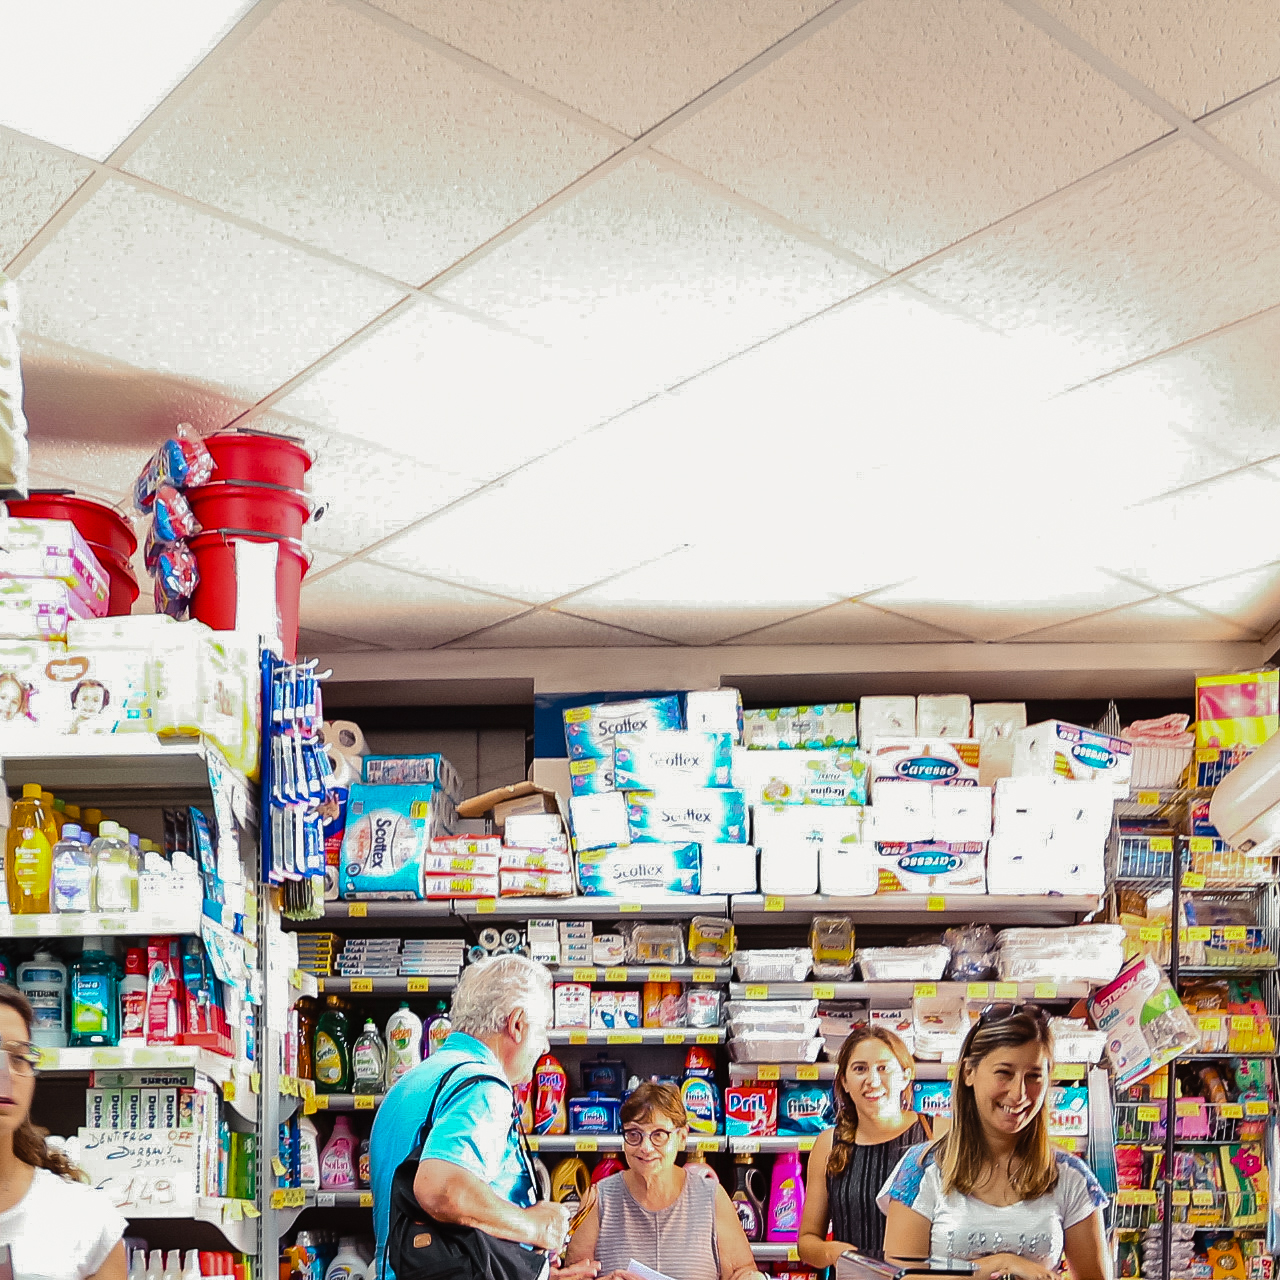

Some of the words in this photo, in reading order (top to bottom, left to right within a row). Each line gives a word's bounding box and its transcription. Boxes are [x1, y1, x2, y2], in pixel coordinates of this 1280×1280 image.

[598, 719, 648, 737] Scottex
[649, 752, 700, 767] Sottex
[897, 761, 956, 776] Caresse
[661, 808, 711, 822] Scttex
[371, 818, 392, 869] Scottex
[901, 856, 960, 870] Caresse
[390, 1028, 412, 1039] Nelsen
[538, 1073, 561, 1085] Pril
[112, 1095, 120, 1128] Durba
[131, 1095, 139, 1128] Durba
[167, 1095, 175, 1128] Durba
[730, 1093, 767, 1112] Pril
[94, 1096, 102, 1128] Durba
[149, 1096, 157, 1128] Durba
[1049, 1109, 1082, 1125] Sun
